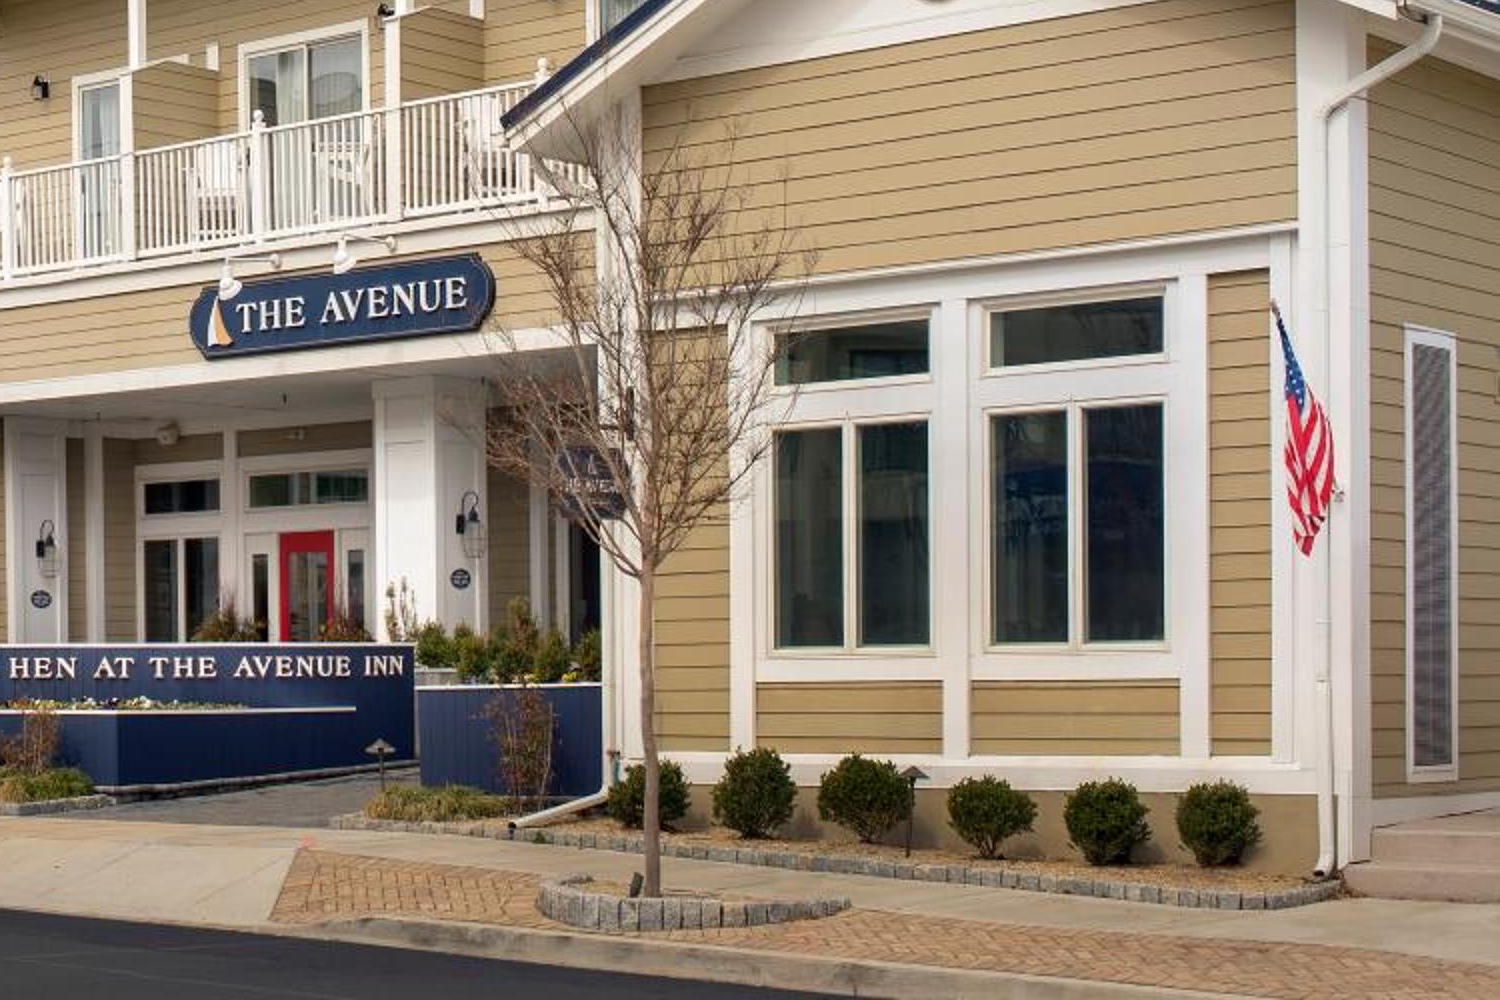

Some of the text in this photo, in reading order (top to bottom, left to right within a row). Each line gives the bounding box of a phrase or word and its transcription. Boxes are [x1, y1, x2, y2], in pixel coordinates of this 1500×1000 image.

[236, 276, 468, 334] THE AVENUE
[9, 657, 77, 680] HEN
[93, 657, 135, 679] AT
[149, 656, 218, 679] THE
[233, 655, 352, 678] AVENUE
[364, 654, 405, 677] INN
